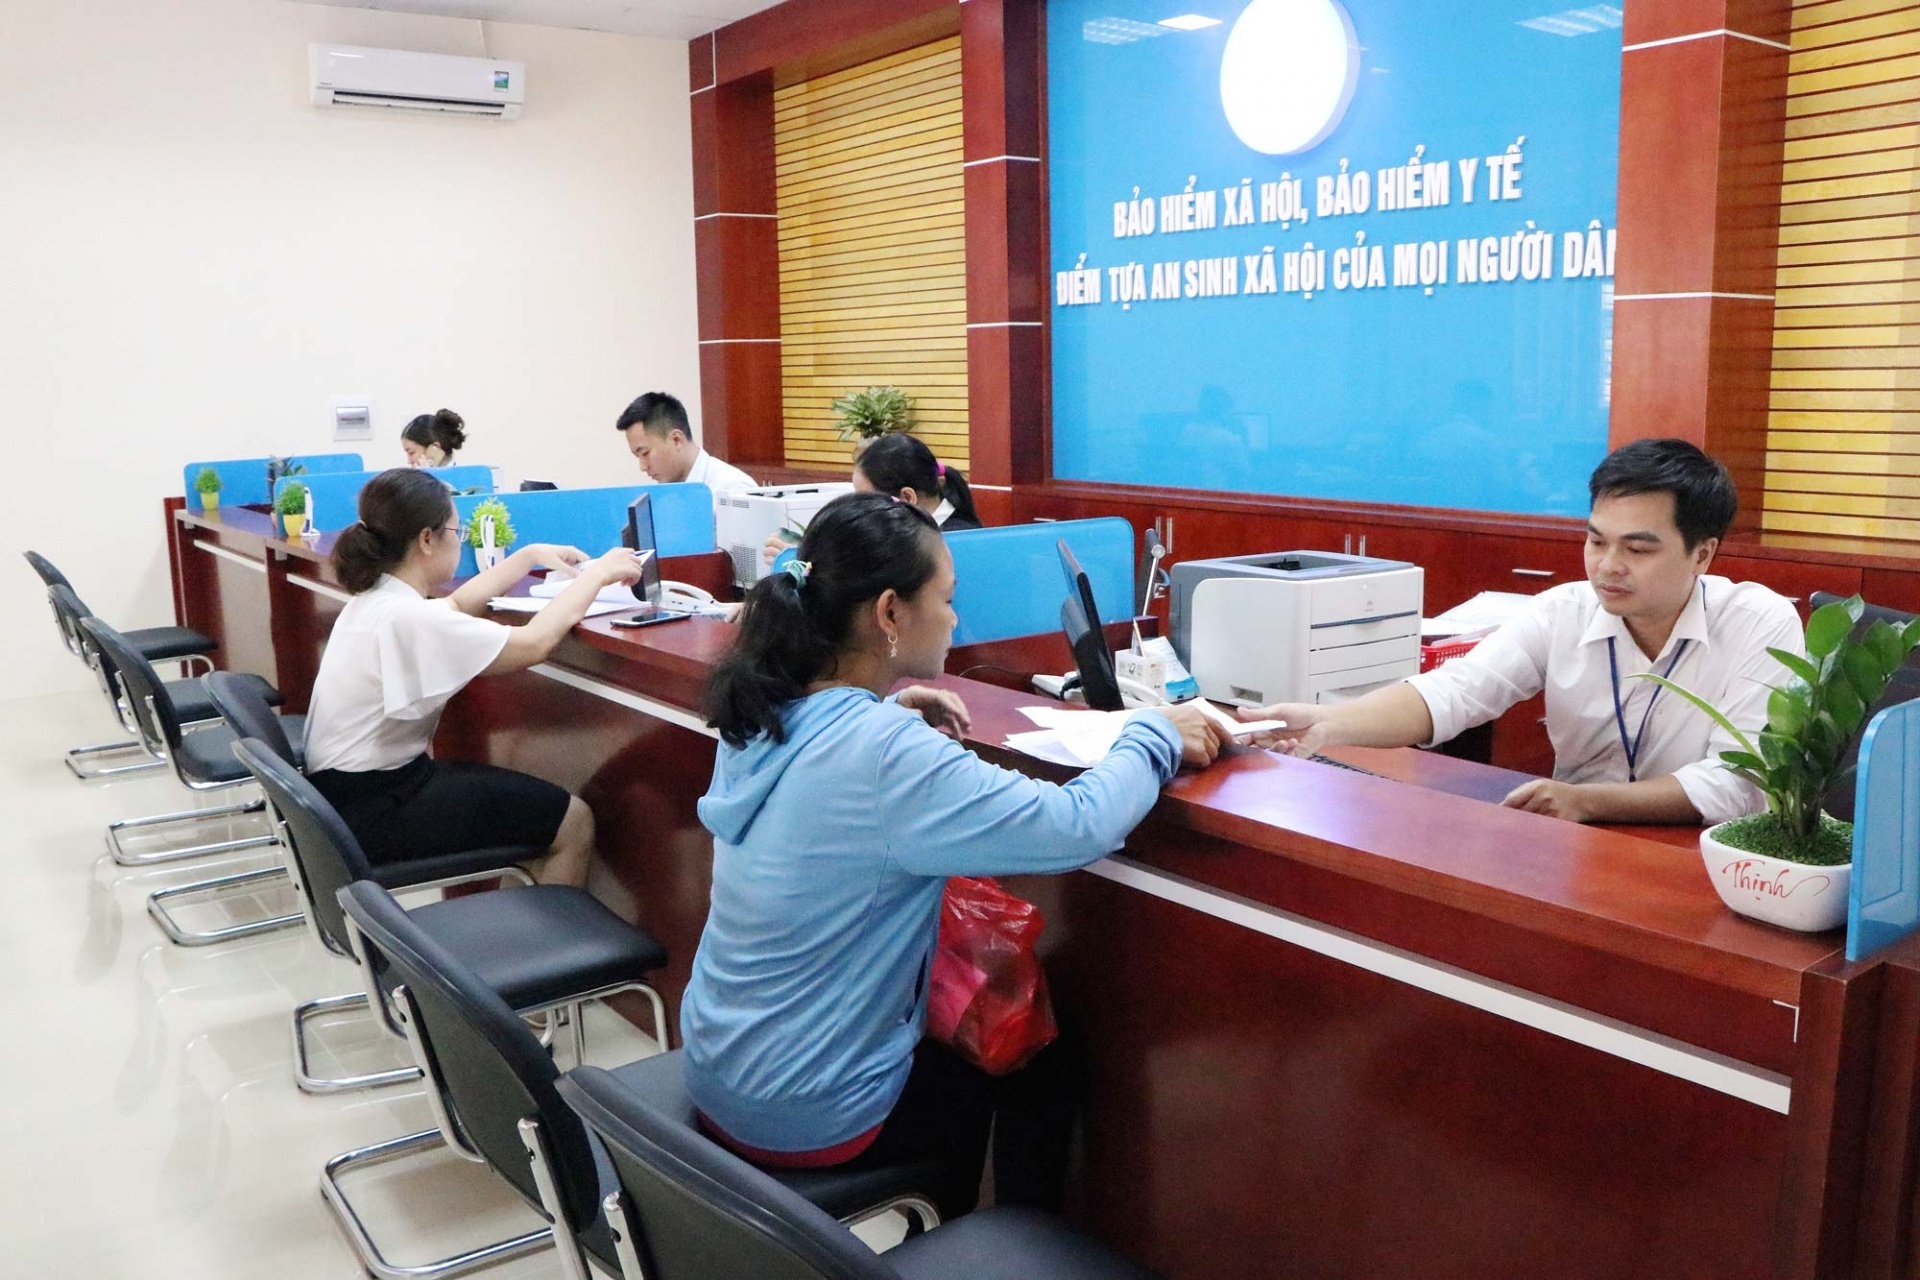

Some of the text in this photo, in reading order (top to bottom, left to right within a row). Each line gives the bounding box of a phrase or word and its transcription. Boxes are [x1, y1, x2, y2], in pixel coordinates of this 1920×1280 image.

[1114, 135, 1526, 238] BẢO HIỂM XÃ HỘI, BẢO HIỂM Y TẾ
[1108, 261, 1147, 310] TỰA
[1151, 261, 1181, 300] AN
[1184, 256, 1238, 298] SINH
[1244, 245, 1277, 294] XÃ
[1283, 241, 1326, 300] HỘI
[1333, 230, 1387, 290] CỦA
[1394, 240, 1448, 295] MỌI
[1457, 220, 1554, 283] NGƯỜI
